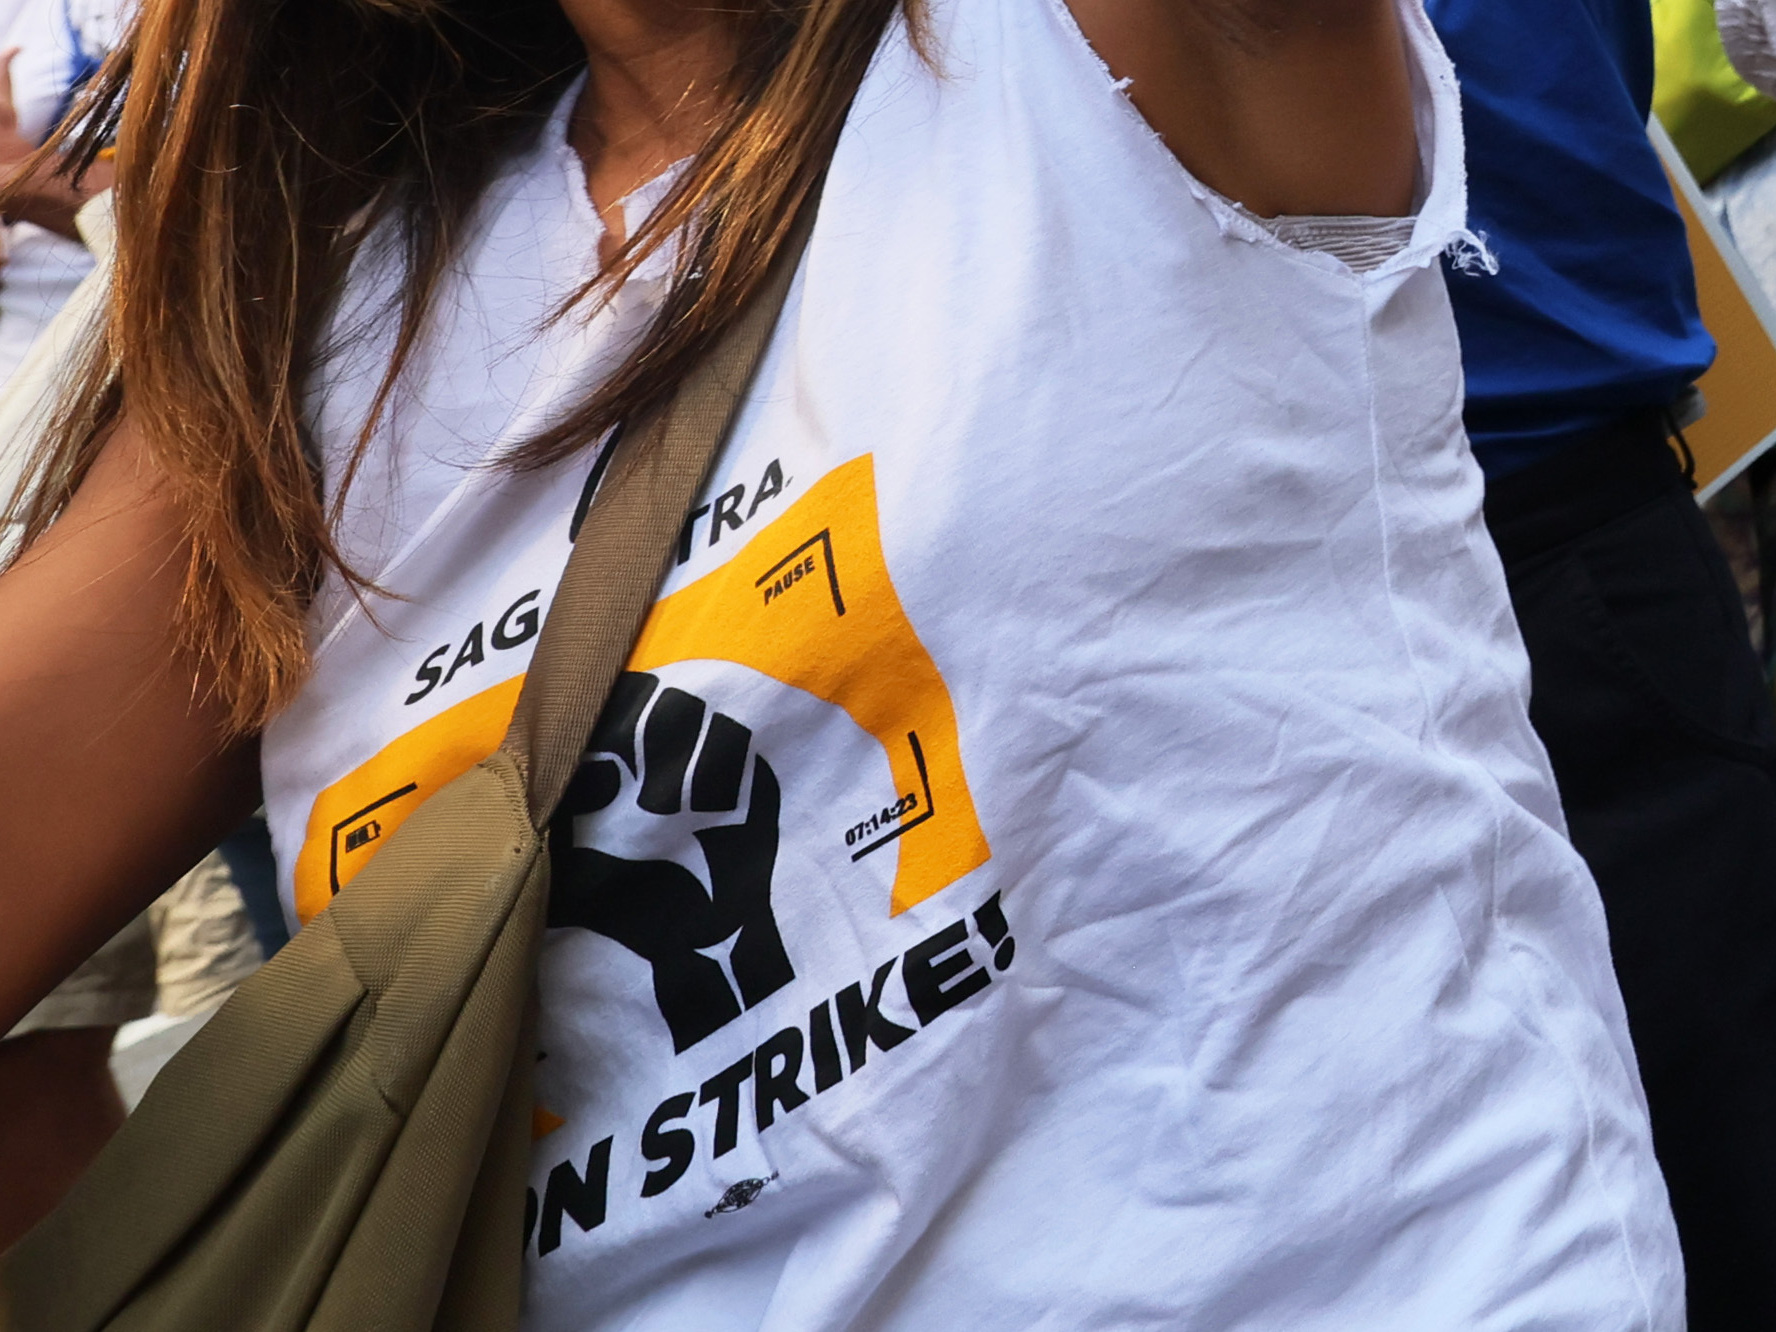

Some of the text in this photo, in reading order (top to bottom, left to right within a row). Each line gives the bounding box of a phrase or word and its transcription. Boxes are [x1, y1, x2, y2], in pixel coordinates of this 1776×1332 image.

[763, 553, 816, 608] PAUSE
[844, 790, 918, 848] 07:14:23
[640, 889, 1016, 1200] STRIKE!
